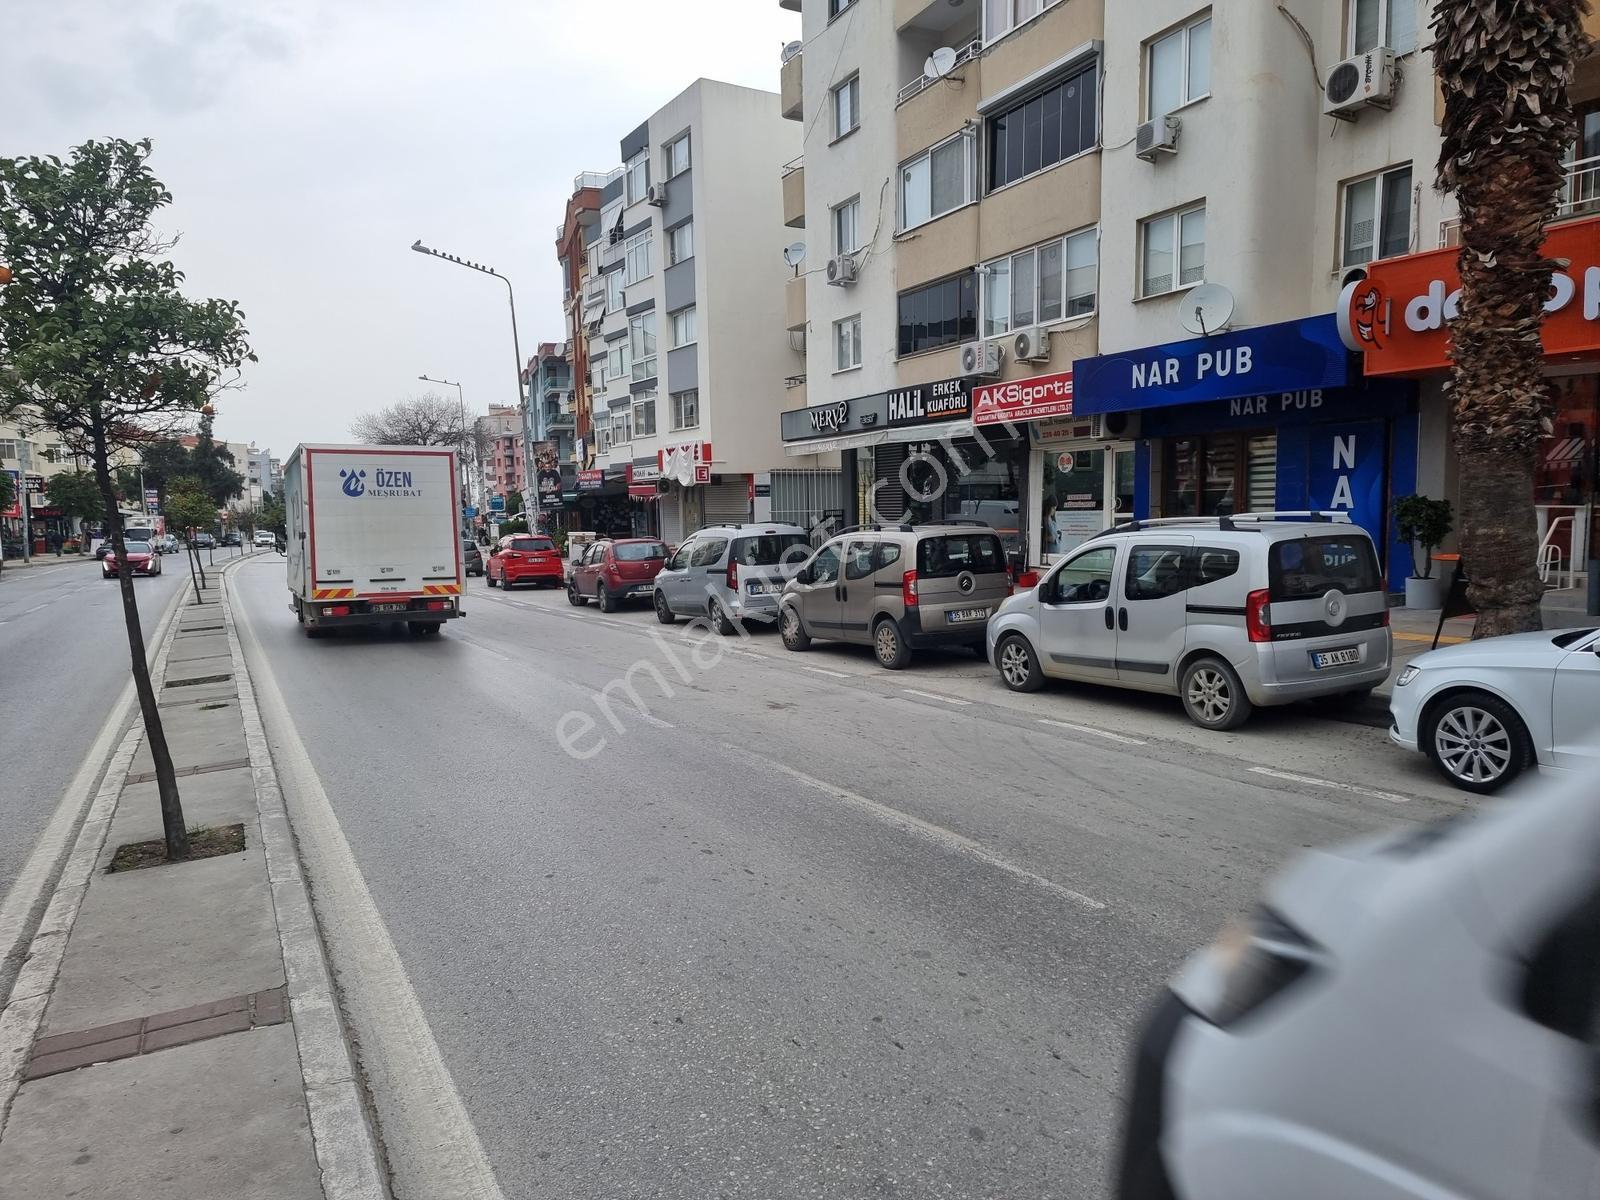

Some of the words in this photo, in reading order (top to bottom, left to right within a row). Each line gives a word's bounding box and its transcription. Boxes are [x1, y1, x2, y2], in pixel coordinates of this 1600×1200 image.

[1132, 358, 1180, 389] NAR
[1197, 346, 1253, 380] PUB
[932, 380, 961, 397] ERKEK
[927, 392, 967, 413] KUAFÖRÜ
[1230, 396, 1267, 417] NAR
[1281, 389, 1323, 411] PUB
[376, 468, 412, 488] ÖZEN
[1330, 435, 1356, 523] NA
[368, 489, 423, 499] MEŞRUBAT
[1318, 654, 1329, 665] 35
